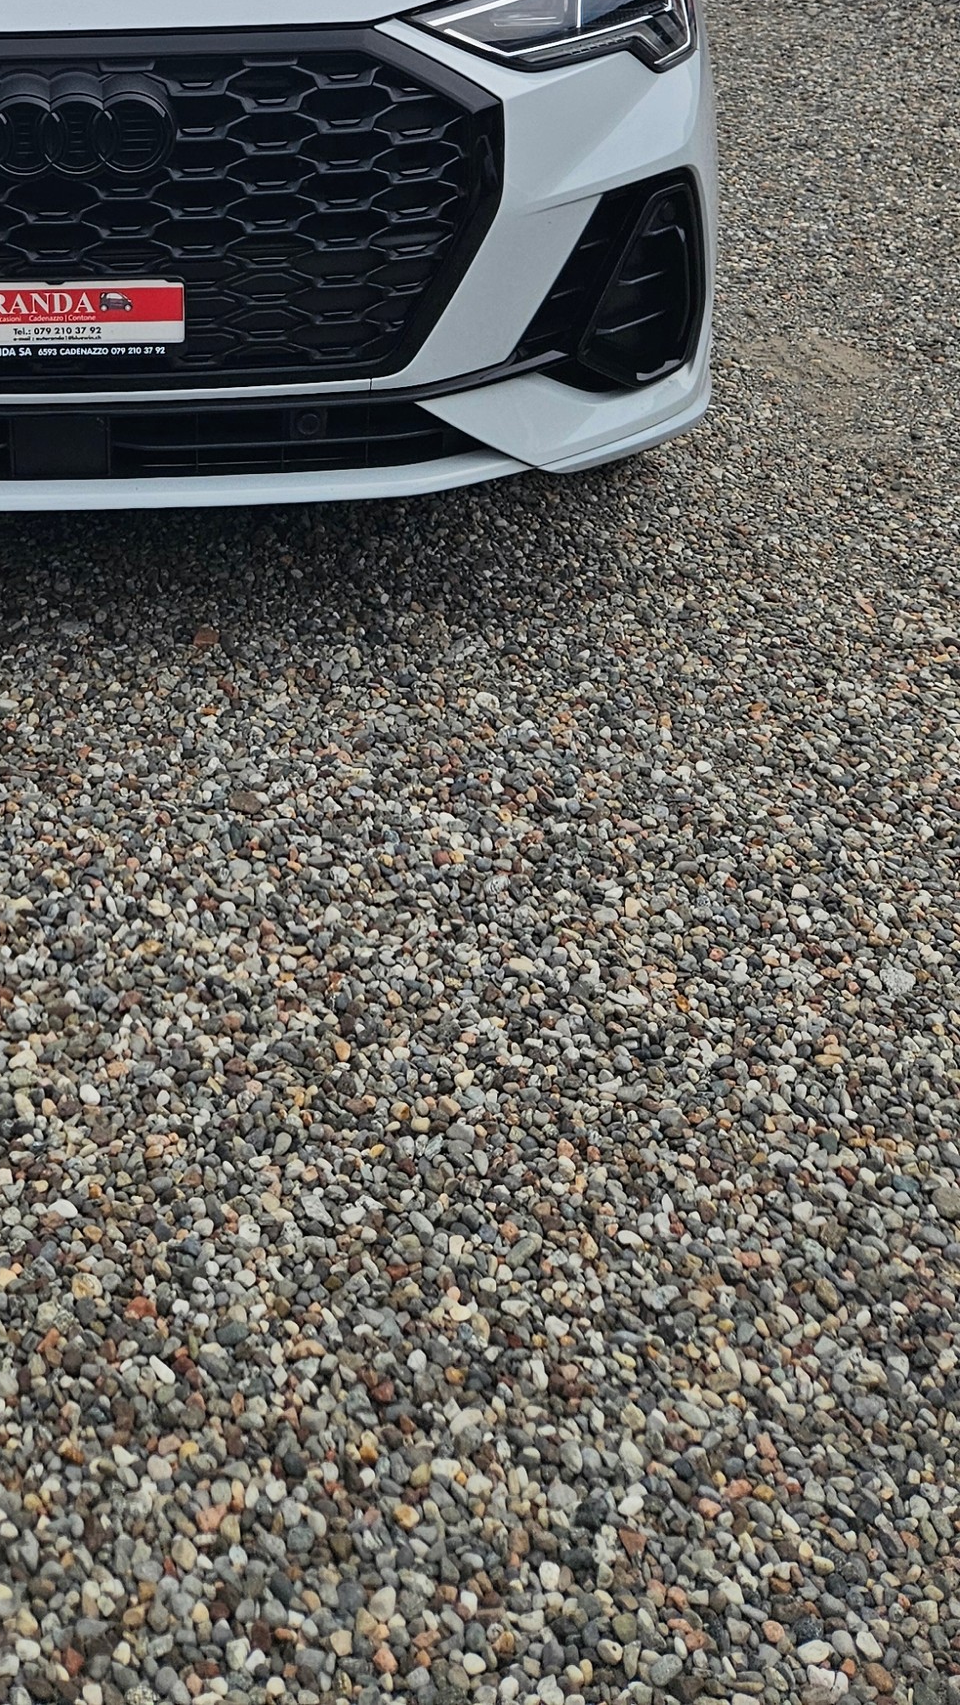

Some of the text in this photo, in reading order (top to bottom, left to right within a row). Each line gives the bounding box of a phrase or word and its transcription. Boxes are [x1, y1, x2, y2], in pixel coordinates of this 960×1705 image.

[68, 314, 96, 322] Contone
[13, 326, 102, 336] Tel.: 079 210 37 92
[18, 347, 32, 356] SA
[38, 348, 58, 356] 6593
[59, 347, 109, 355] CADENAZZO
[110, 347, 126, 355] 079
[127, 346, 142, 355] 210
[143, 346, 153, 355] 37
[154, 346, 166, 355] 92
